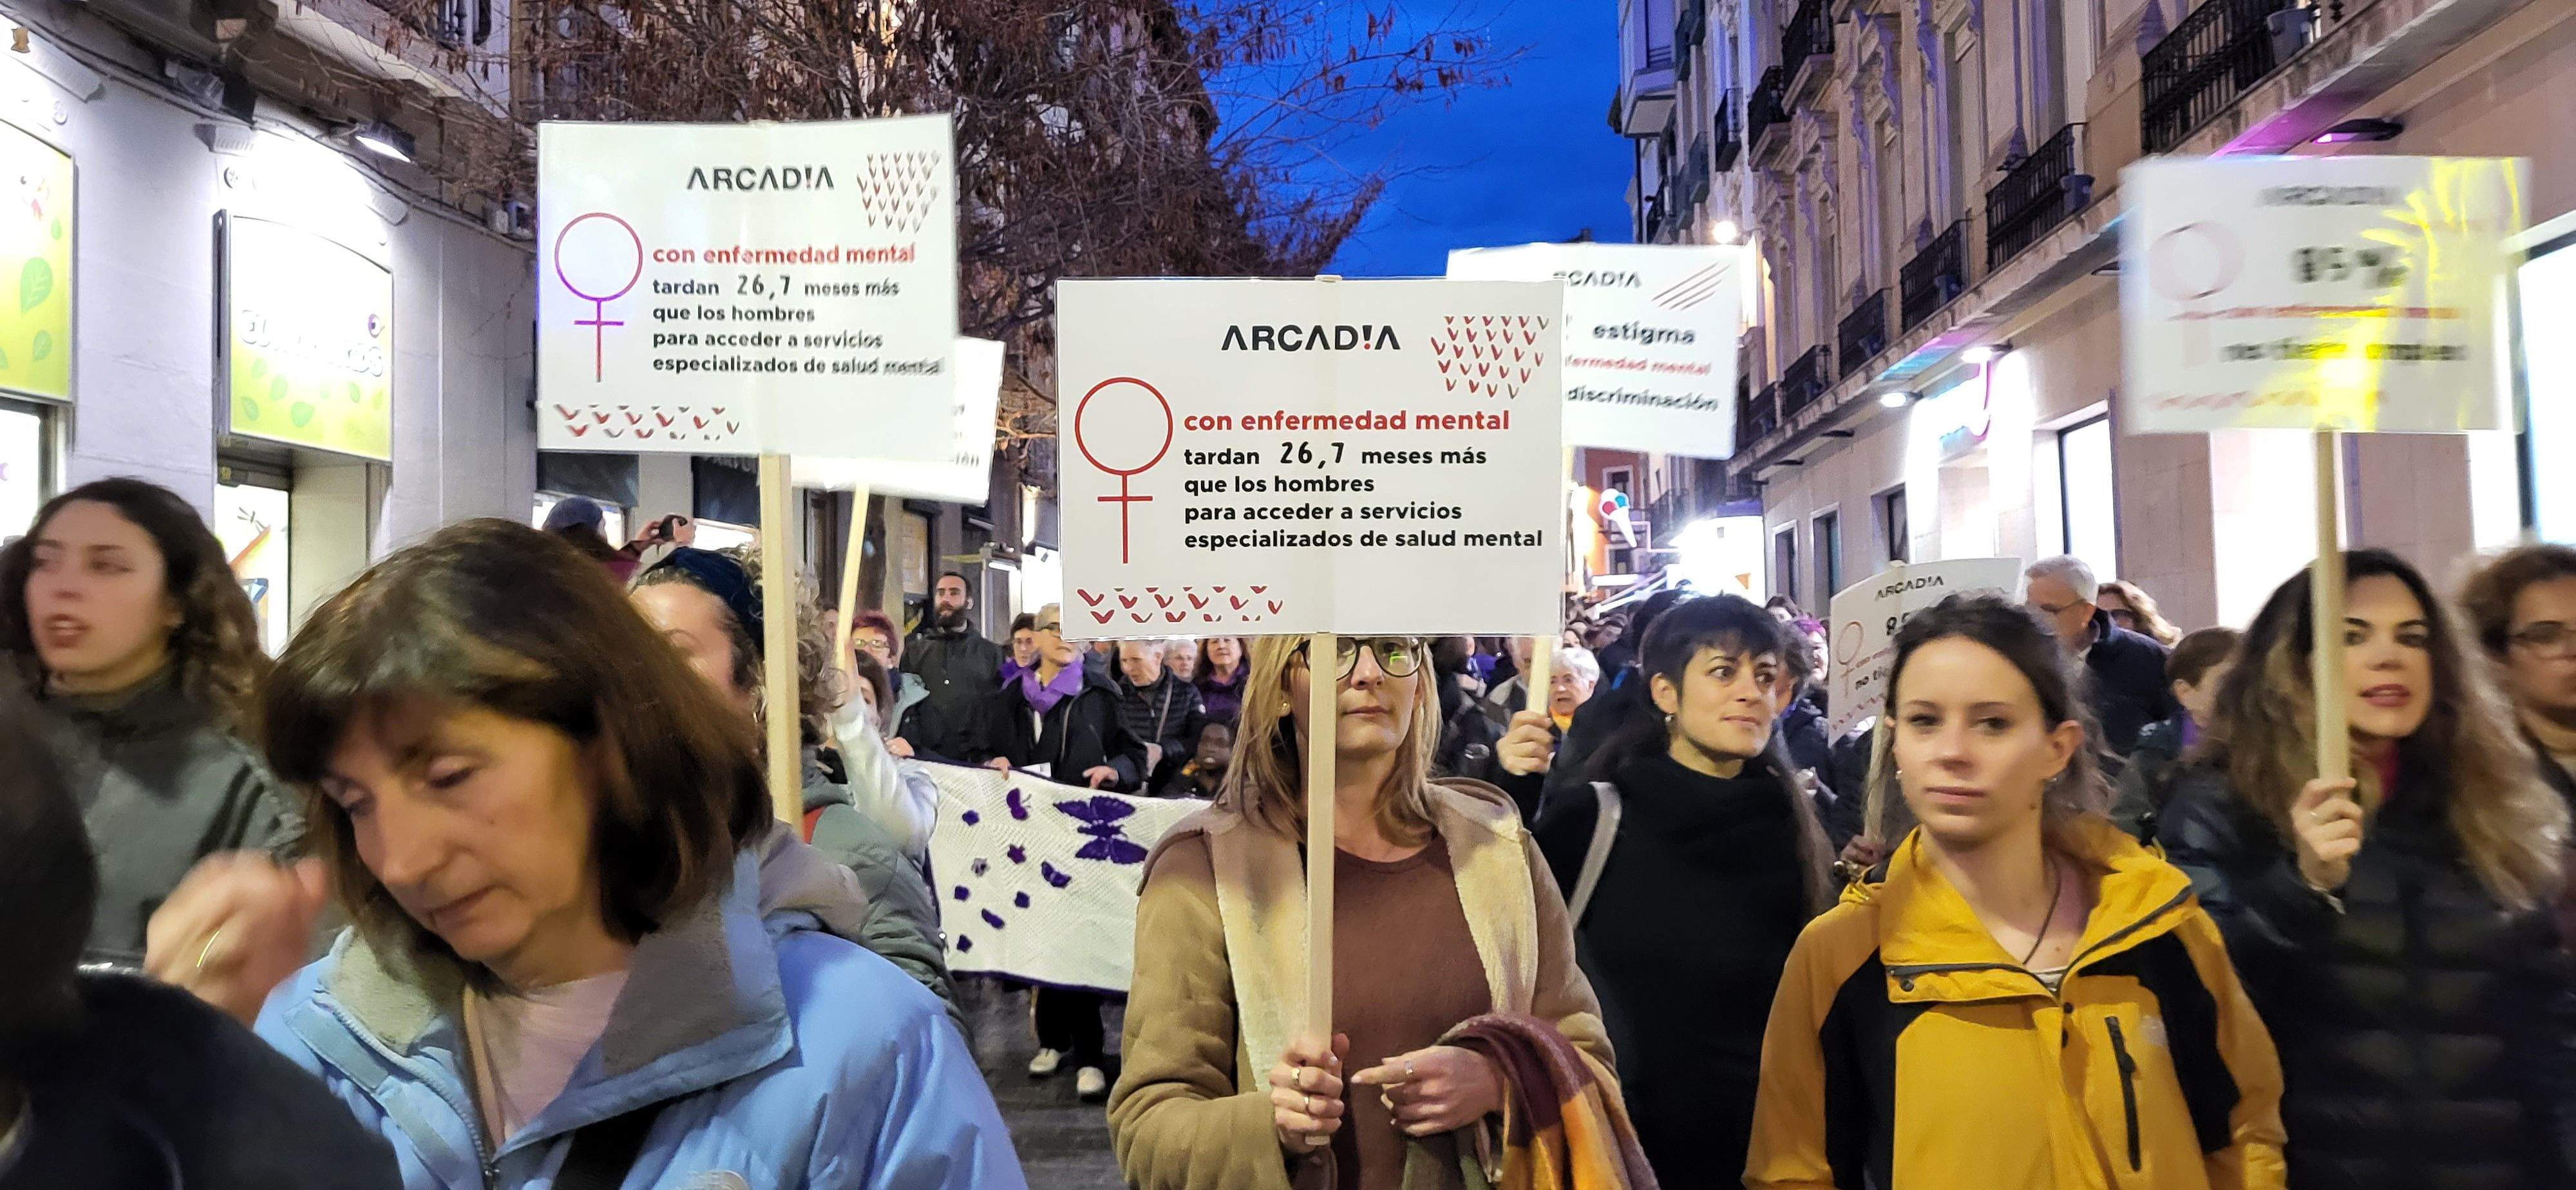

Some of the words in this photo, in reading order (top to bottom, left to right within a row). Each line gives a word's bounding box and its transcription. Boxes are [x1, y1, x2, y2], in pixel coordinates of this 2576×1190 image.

[652, 249, 696, 263] con
[703, 245, 839, 265] enfermedad
[846, 243, 915, 264] mental
[652, 278, 719, 296] tardan
[737, 274, 791, 301] 26,7
[804, 283, 860, 297] meses
[652, 307, 691, 323] que
[697, 305, 726, 321] los
[732, 305, 815, 322] hombres
[653, 333, 699, 349] para
[705, 330, 782, 348] acceder
[788, 334, 798, 347] a
[804, 329, 883, 349] servicios
[1592, 319, 1695, 345] estigma
[652, 354, 798, 375] especializados
[804, 357, 826, 373] de
[831, 357, 879, 375] salud
[1184, 415, 1232, 431] con
[1241, 410, 1406, 431] enfermedad
[1416, 410, 1509, 430] mental
[1184, 448, 1260, 466] tardan
[1280, 441, 1345, 470] 26,7
[1361, 451, 1433, 464] meses
[1441, 446, 1487, 464] más
[1184, 479, 1227, 496] que
[1235, 475, 1267, 493] los
[1274, 475, 1375, 493] hombres
[1185, 507, 1236, 524] para
[1243, 503, 1334, 520] acceder
[1340, 506, 1353, 520] a
[1360, 501, 1462, 520] servicios
[1184, 529, 1353, 552] especializados
[1359, 529, 1388, 547] de
[1395, 529, 1456, 547] salud
[1464, 529, 1542, 547] mental
